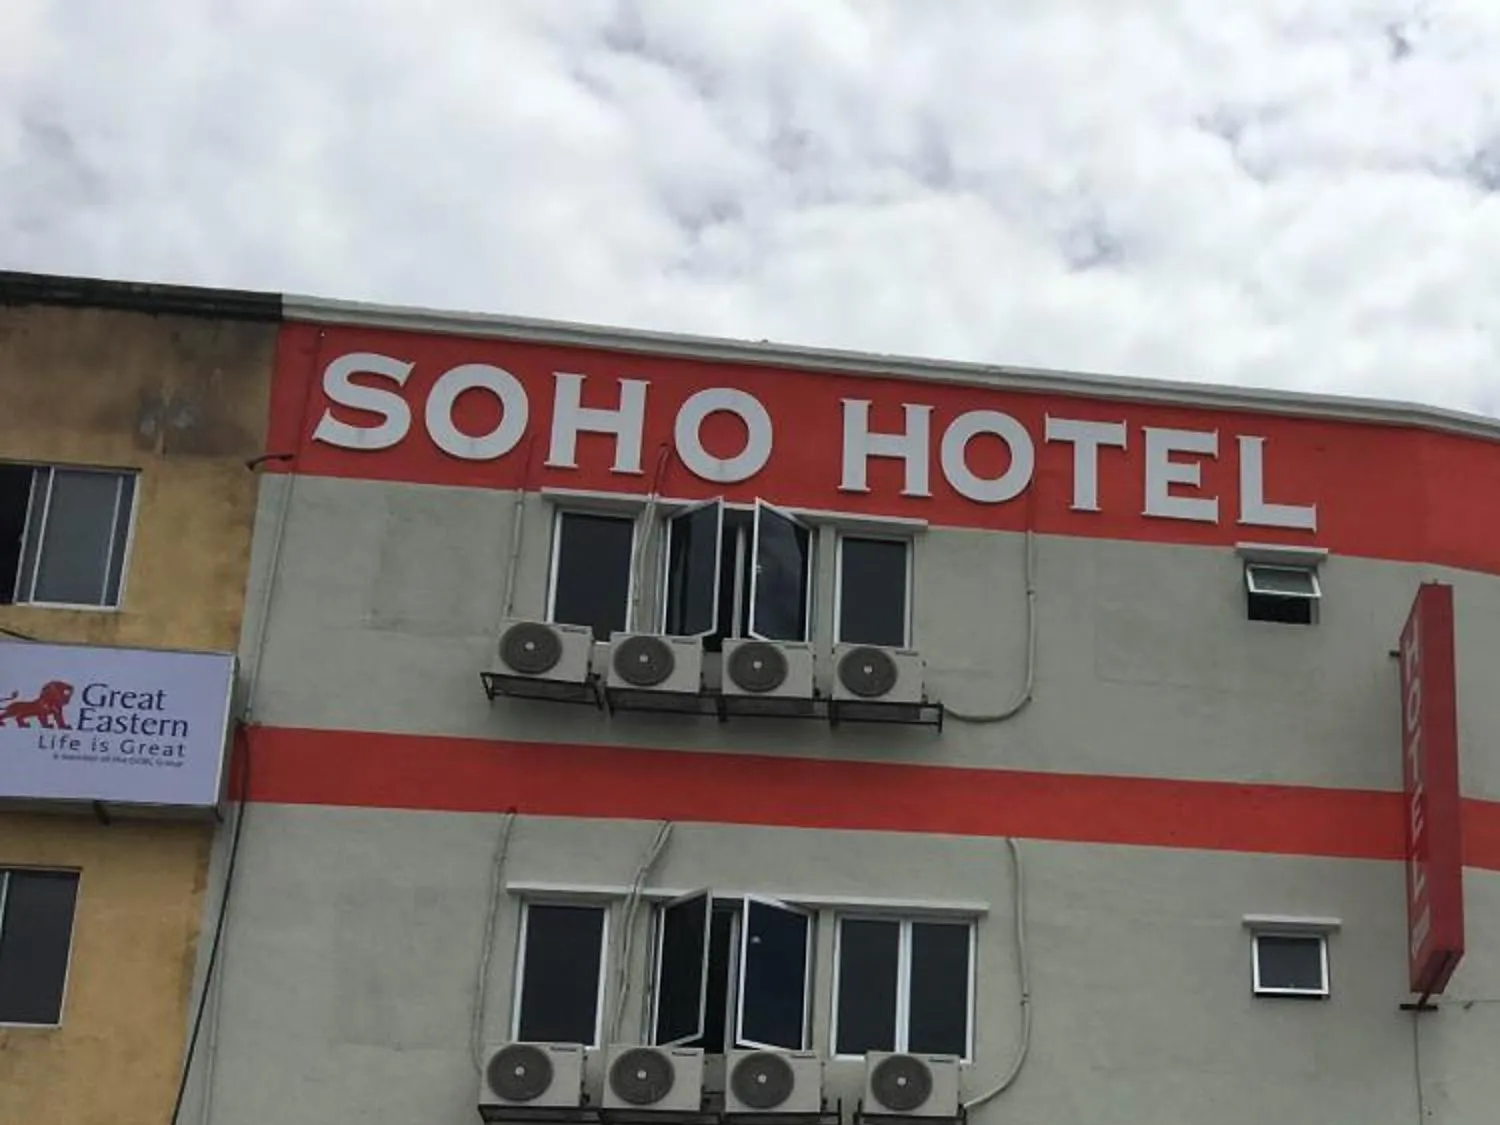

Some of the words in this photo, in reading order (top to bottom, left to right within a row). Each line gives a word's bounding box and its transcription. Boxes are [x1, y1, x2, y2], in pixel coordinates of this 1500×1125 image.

[312, 352, 774, 484] SOHO
[837, 398, 1317, 533] HOTEL
[82, 682, 168, 712] Great
[76, 707, 190, 737] Eastern
[37, 734, 82, 751] Life
[90, 737, 110, 753] is
[119, 739, 188, 757] Great
[1404, 612, 1426, 906] HOTEL
